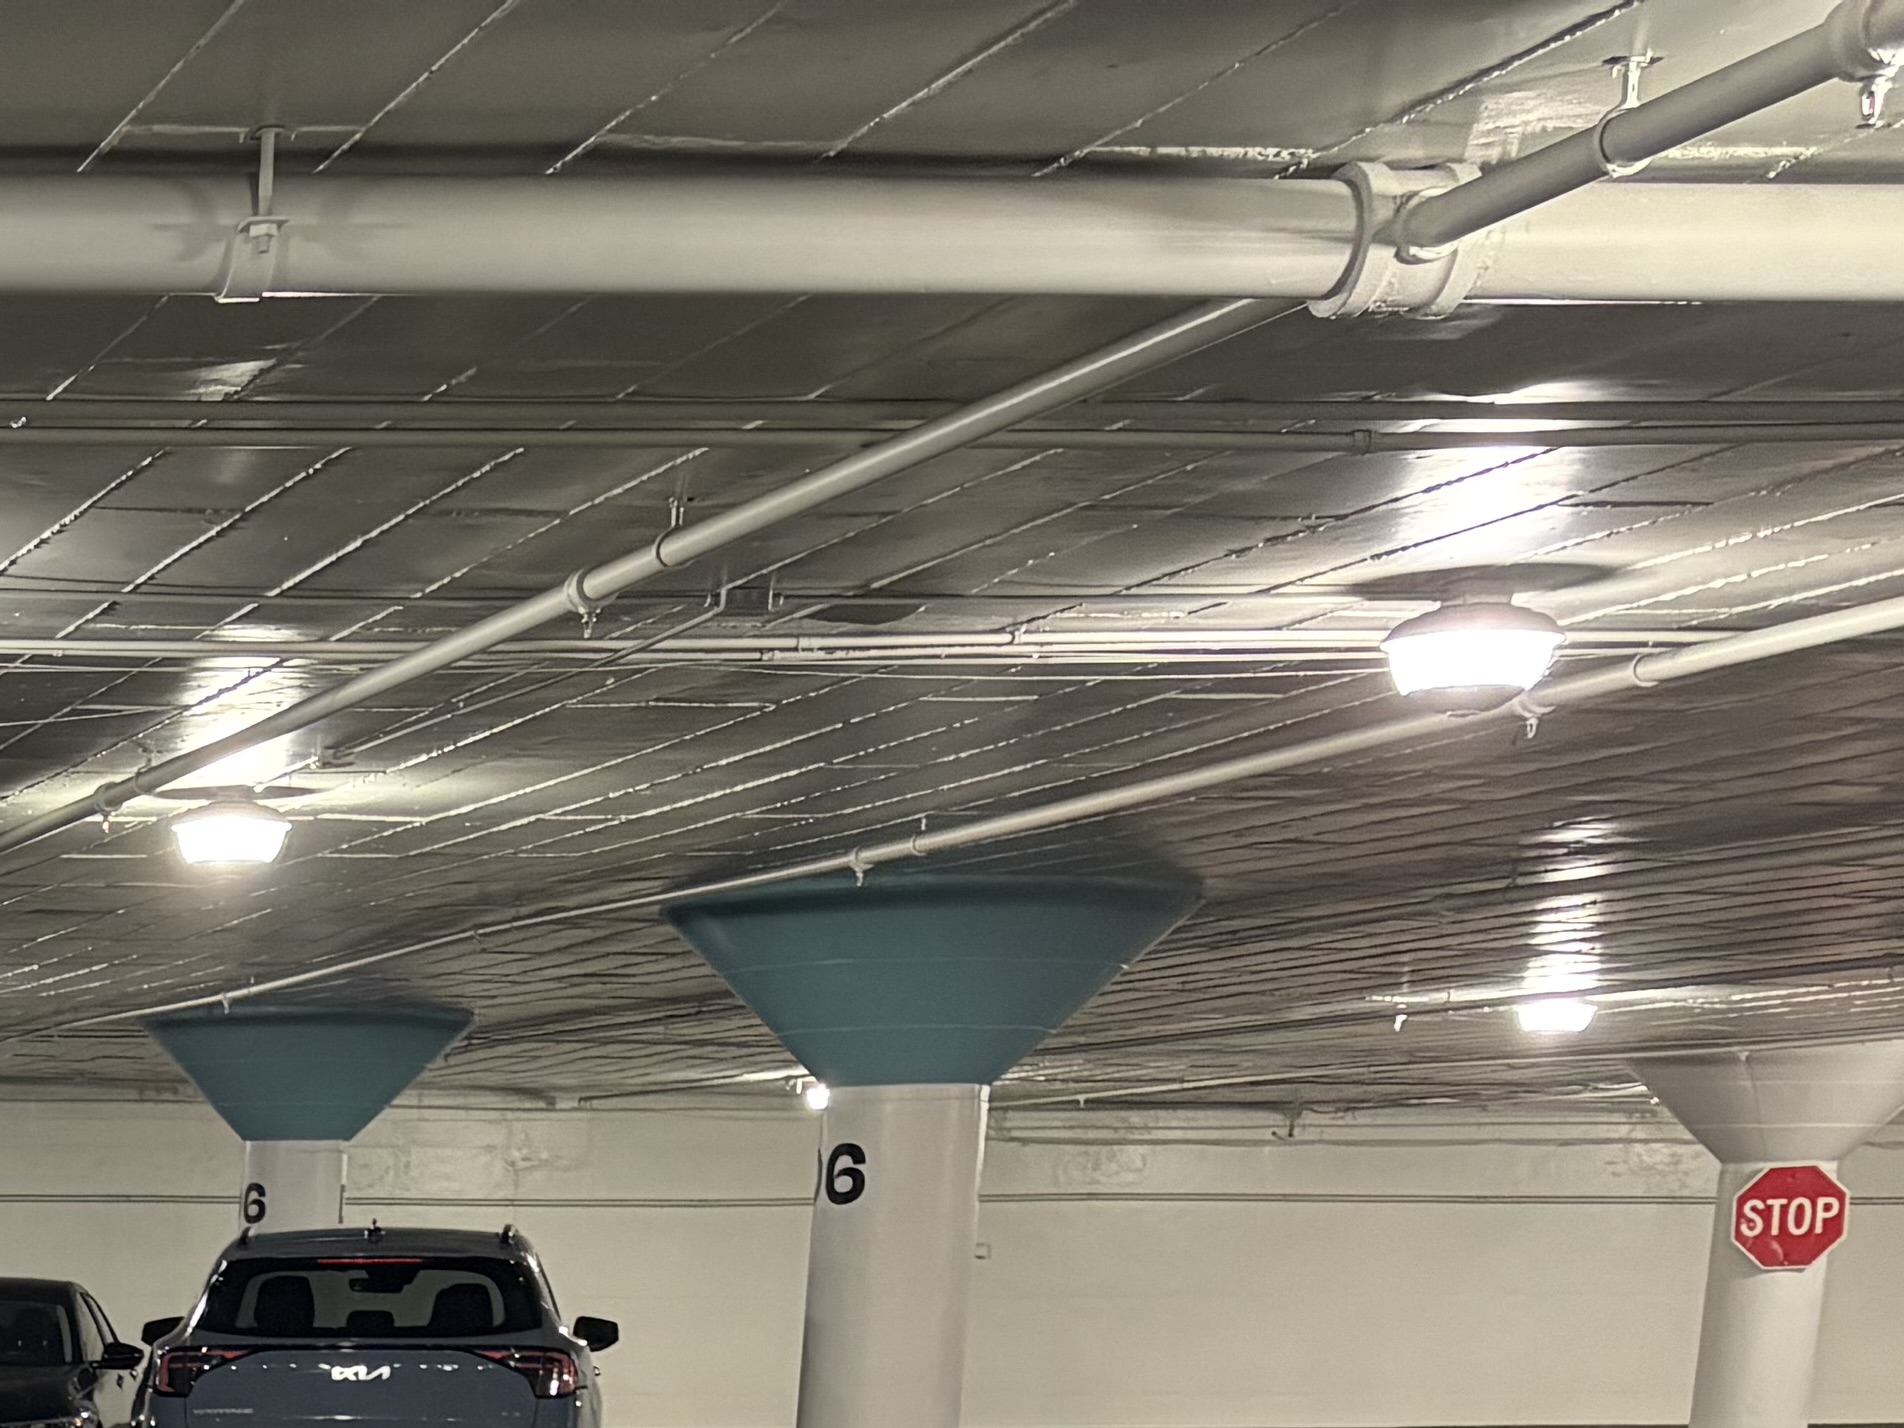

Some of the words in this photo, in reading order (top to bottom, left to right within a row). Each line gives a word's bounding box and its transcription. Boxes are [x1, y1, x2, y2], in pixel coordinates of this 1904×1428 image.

[816, 1142, 867, 1206] 6
[243, 1182, 267, 1224] 6
[1739, 1196, 1841, 1238] STOP
